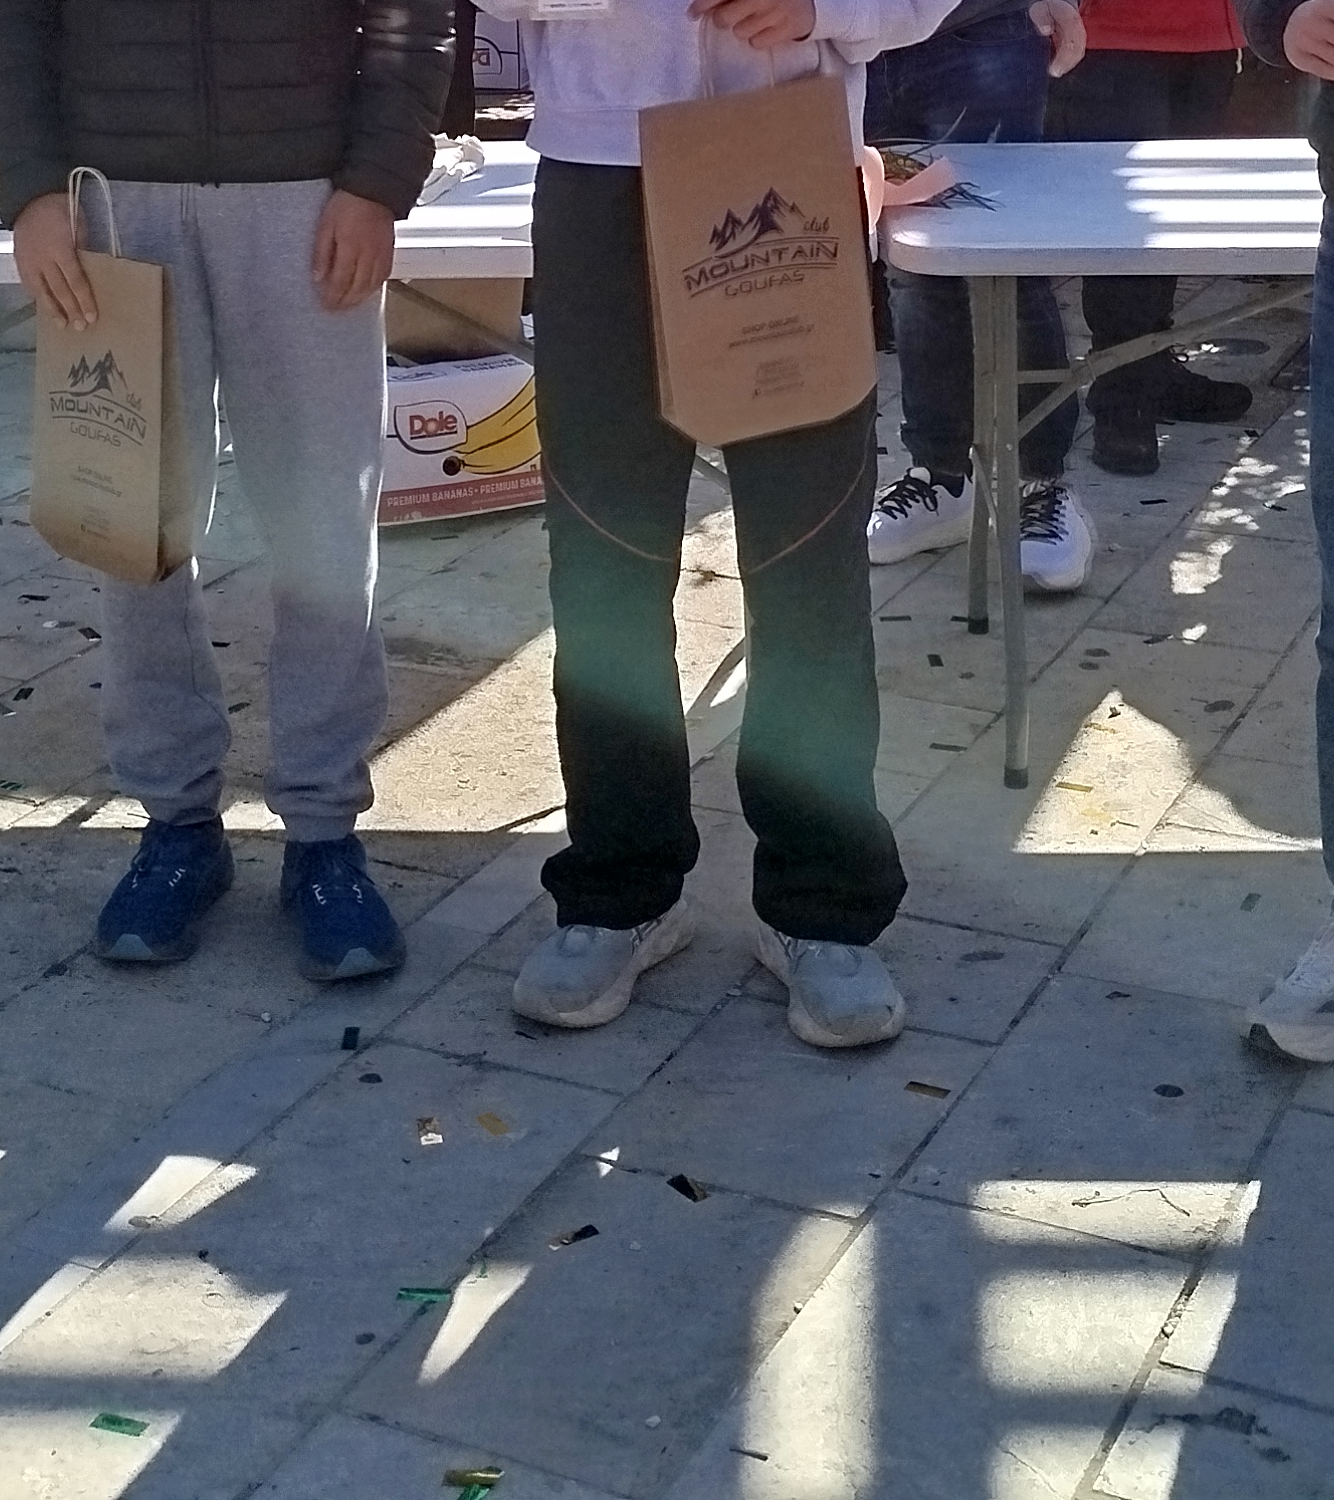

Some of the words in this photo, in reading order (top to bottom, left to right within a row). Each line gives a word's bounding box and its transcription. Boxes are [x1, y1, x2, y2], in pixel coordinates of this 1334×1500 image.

[683, 241, 839, 292] MOUNTAIN
[724, 268, 806, 297] GOUFAS
[50, 395, 147, 440] MOUNTAIN
[409, 410, 458, 436] Dole
[69, 420, 121, 448] GOUFAS
[387, 492, 430, 508] PREMIUM
[432, 486, 474, 503] BANANAS
[479, 478, 520, 495] PREMIUM
[519, 474, 543, 489] BANA
